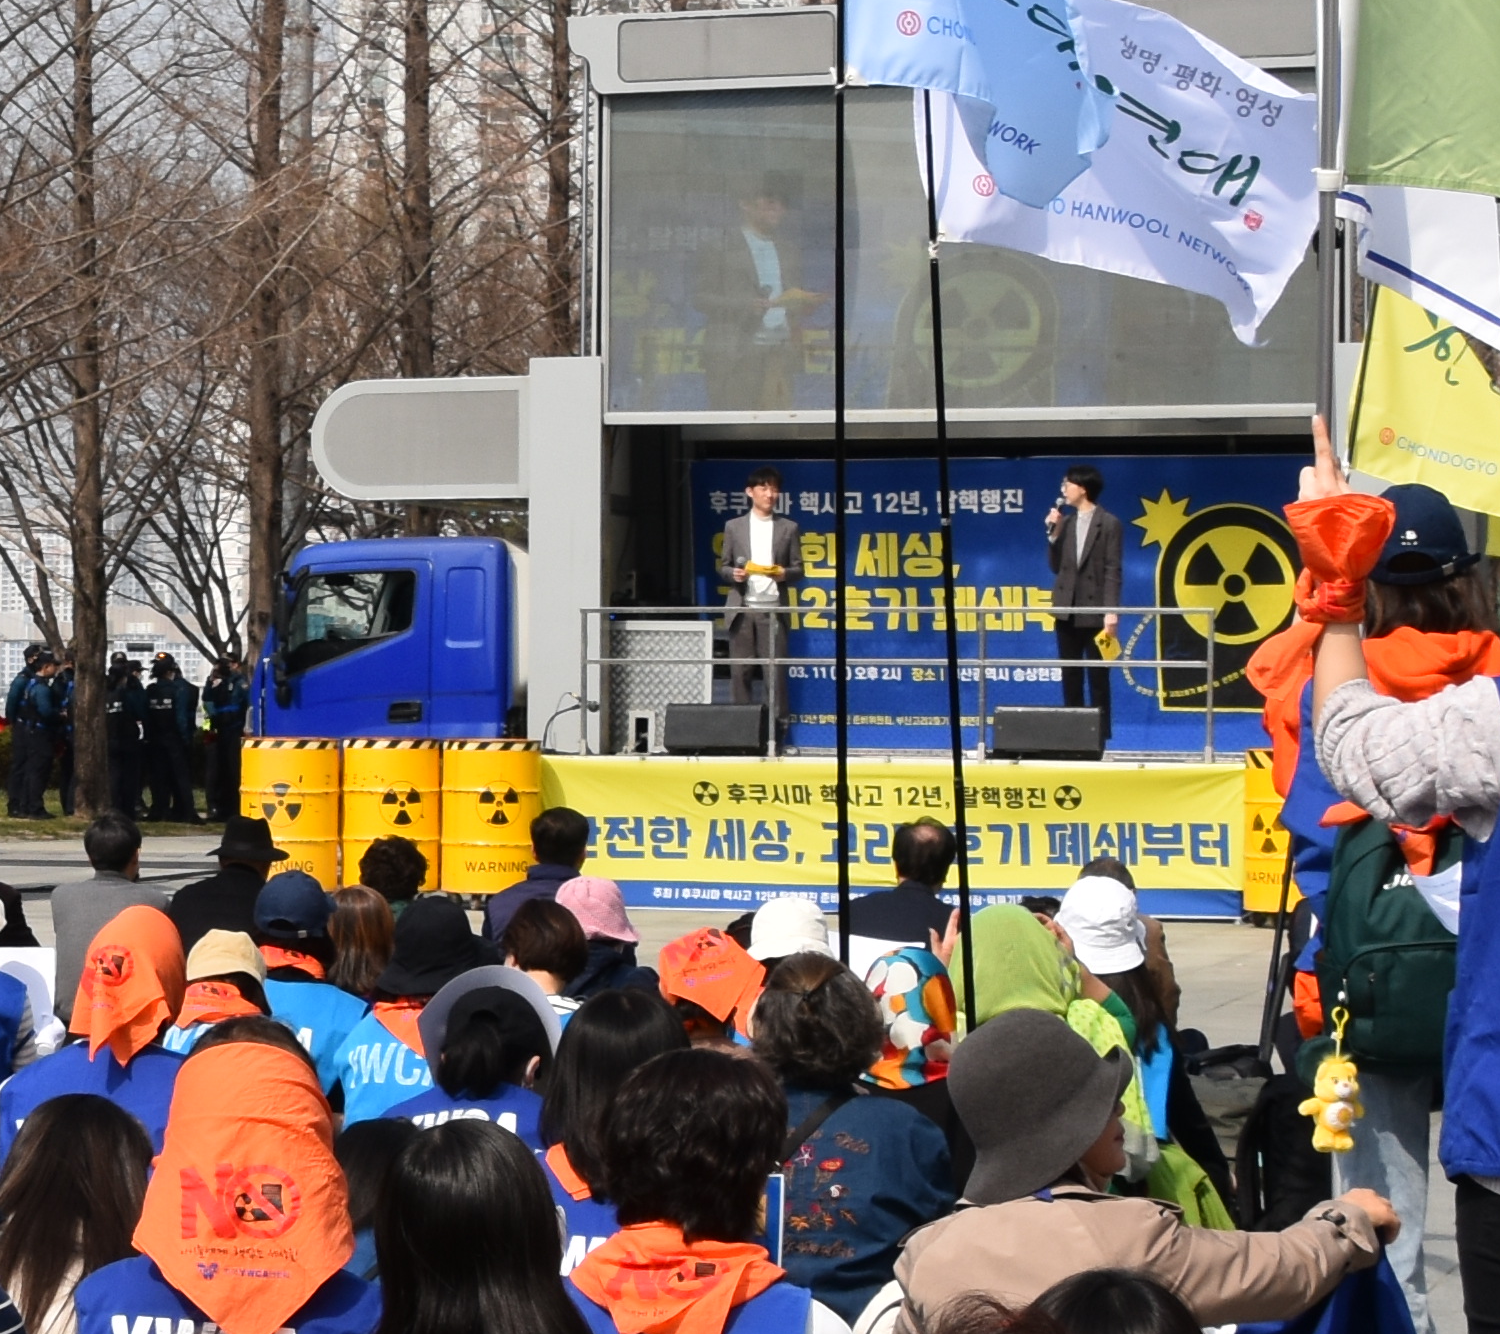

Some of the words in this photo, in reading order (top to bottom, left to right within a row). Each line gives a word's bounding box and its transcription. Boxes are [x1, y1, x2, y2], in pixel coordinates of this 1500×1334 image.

[1070, 202, 1171, 240] HANWOOL
[1396, 435, 1499, 477] CHONDOGYO
[708, 490, 793, 515] 후쿠마
[871, 491, 929, 517] 12년,
[854, 532, 961, 579] 세상,
[931, 585, 1056, 633] 폐쇄부
[855, 667, 878, 681] 오후
[881, 667, 902, 681] 2시
[911, 667, 936, 682] 장소
[957, 667, 1010, 682] 산광역시
[1013, 667, 1062, 682] 송상현광
[726, 784, 812, 806] 후쿠시마
[820, 784, 883, 808] 핵사고
[893, 785, 952, 810] 12년,
[961, 785, 1047, 810] 탈핵행진
[704, 818, 806, 865] 세상,
[820, 820, 1031, 867] 고리호기
[1045, 822, 1230, 867] 폐쇄부터
[270, 860, 314, 873] RNING
[465, 860, 529, 873] WARNING
